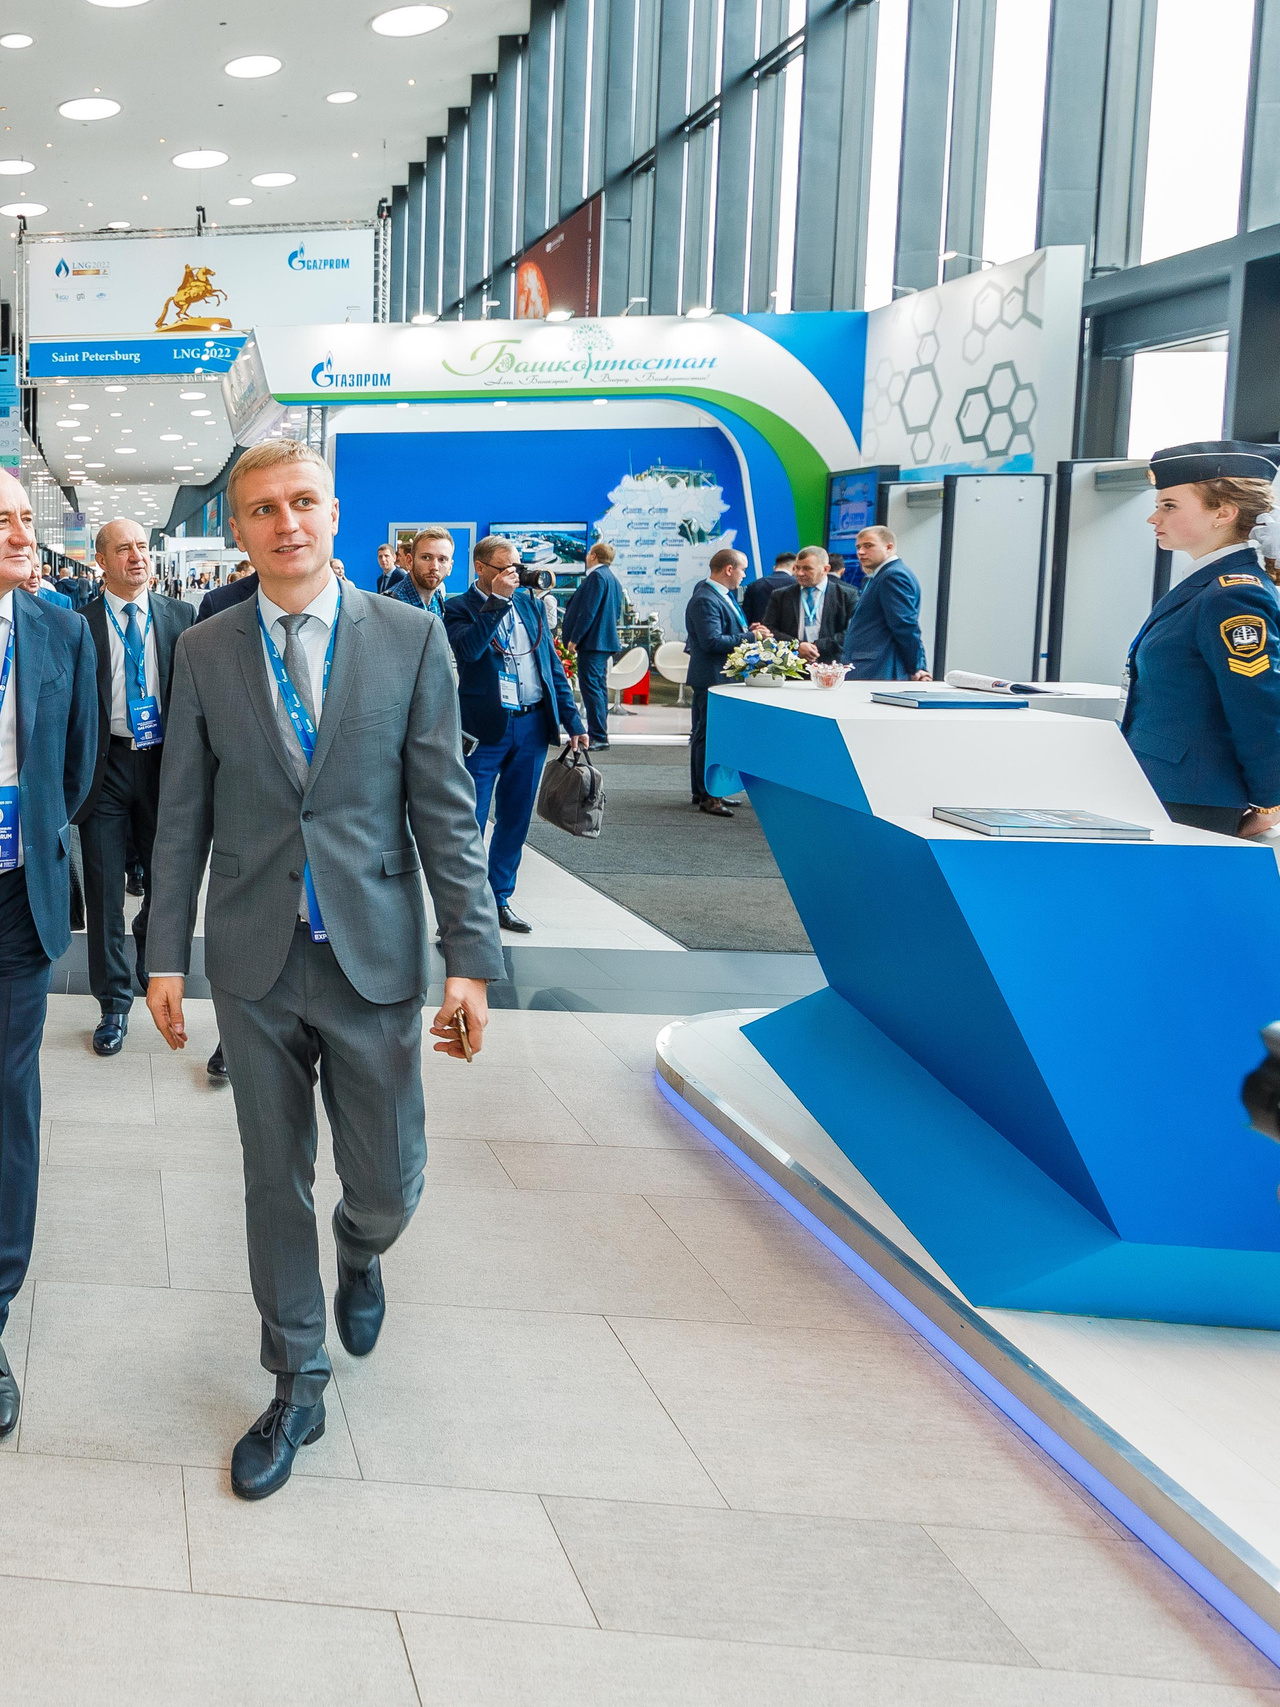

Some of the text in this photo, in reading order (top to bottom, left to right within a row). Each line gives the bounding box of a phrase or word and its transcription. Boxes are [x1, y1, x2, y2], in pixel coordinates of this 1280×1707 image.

[52, 347, 232, 363] Saint Petersburg LNG 2022
